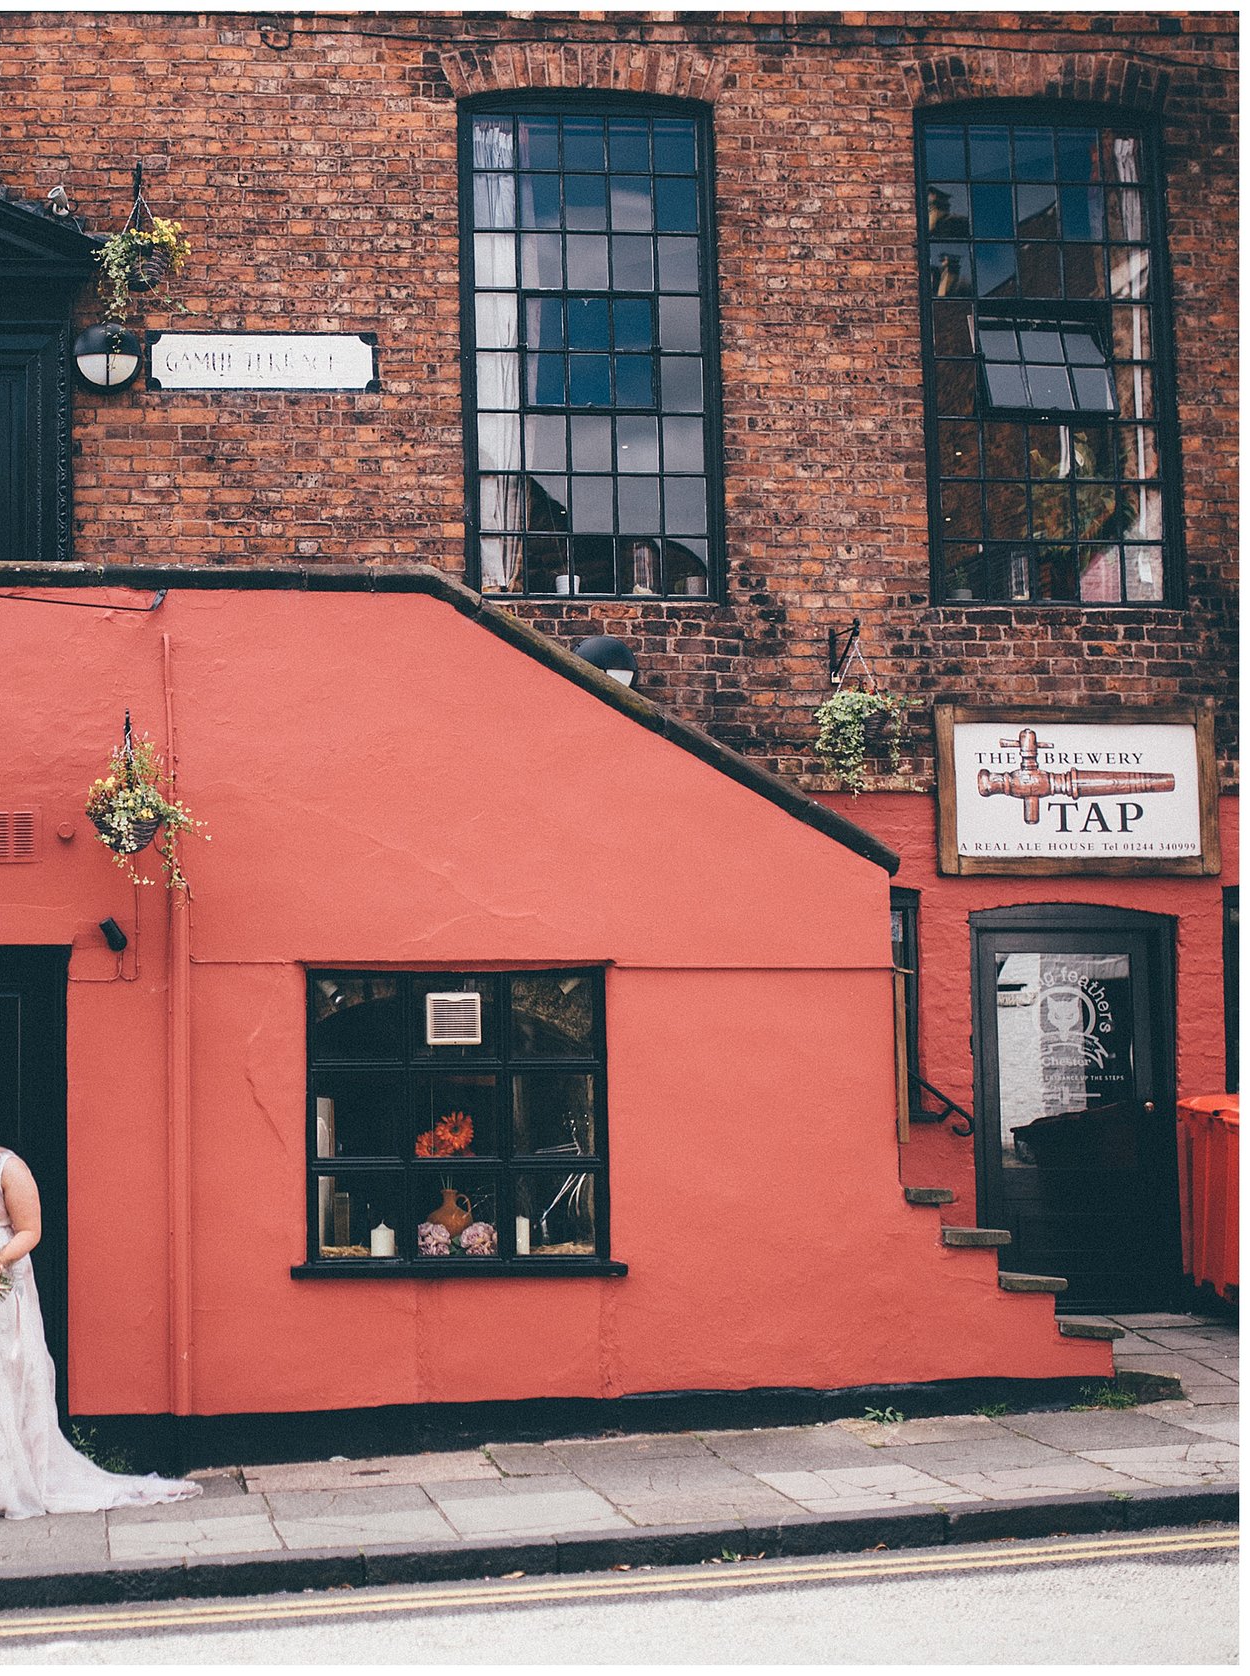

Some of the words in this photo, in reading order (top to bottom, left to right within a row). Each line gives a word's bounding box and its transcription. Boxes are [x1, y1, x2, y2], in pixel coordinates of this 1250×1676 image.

[974, 752, 1017, 765] THE
[1044, 752, 1144, 765] BREWERY
[1047, 802, 1144, 833] TAP
[960, 842, 968, 851] A
[975, 842, 1010, 851] REAL
[1017, 842, 1042, 851] ALE
[1048, 842, 1095, 851] HOUSE
[1102, 842, 1119, 851] Tel
[1123, 842, 1154, 851] 01244
[1159, 842, 1197, 851] 340999
[1060, 966, 1113, 1034] feathers
[1041, 1056, 1092, 1067] Chester
